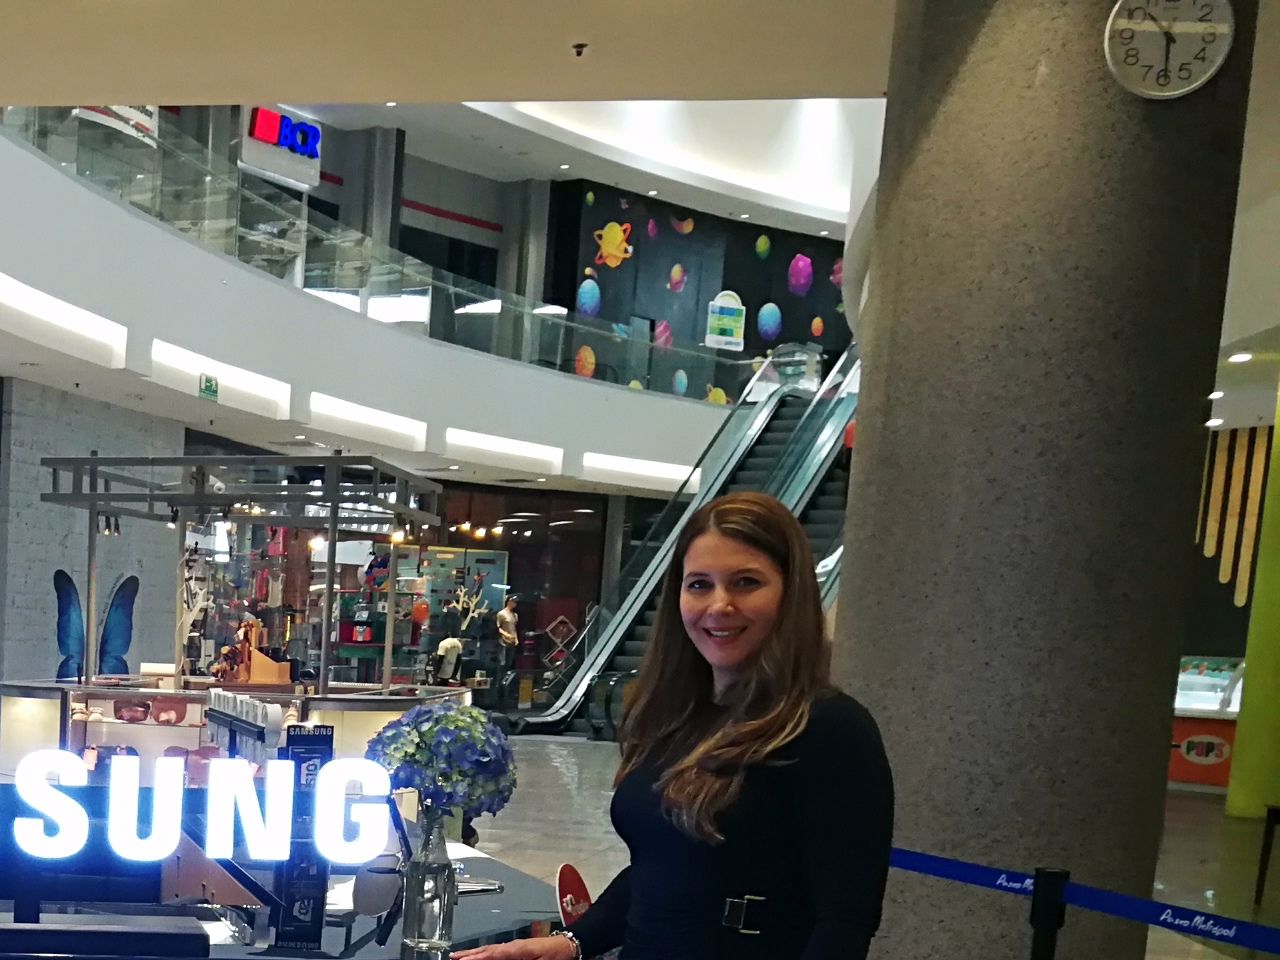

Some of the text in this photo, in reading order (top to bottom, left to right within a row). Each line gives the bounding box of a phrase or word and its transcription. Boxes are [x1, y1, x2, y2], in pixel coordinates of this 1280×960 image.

[1197, 3, 1214, 23] 2
[1119, 27, 1135, 46] 9
[1123, 47, 1139, 66] 8
[1193, 46, 1208, 63] 4
[1140, 64, 1155, 82] 7
[1155, 68, 1172, 87] 6
[1177, 62, 1193, 80] 5
[279, 114, 321, 159] BCR
[289, 727, 332, 736] SAMSUNG
